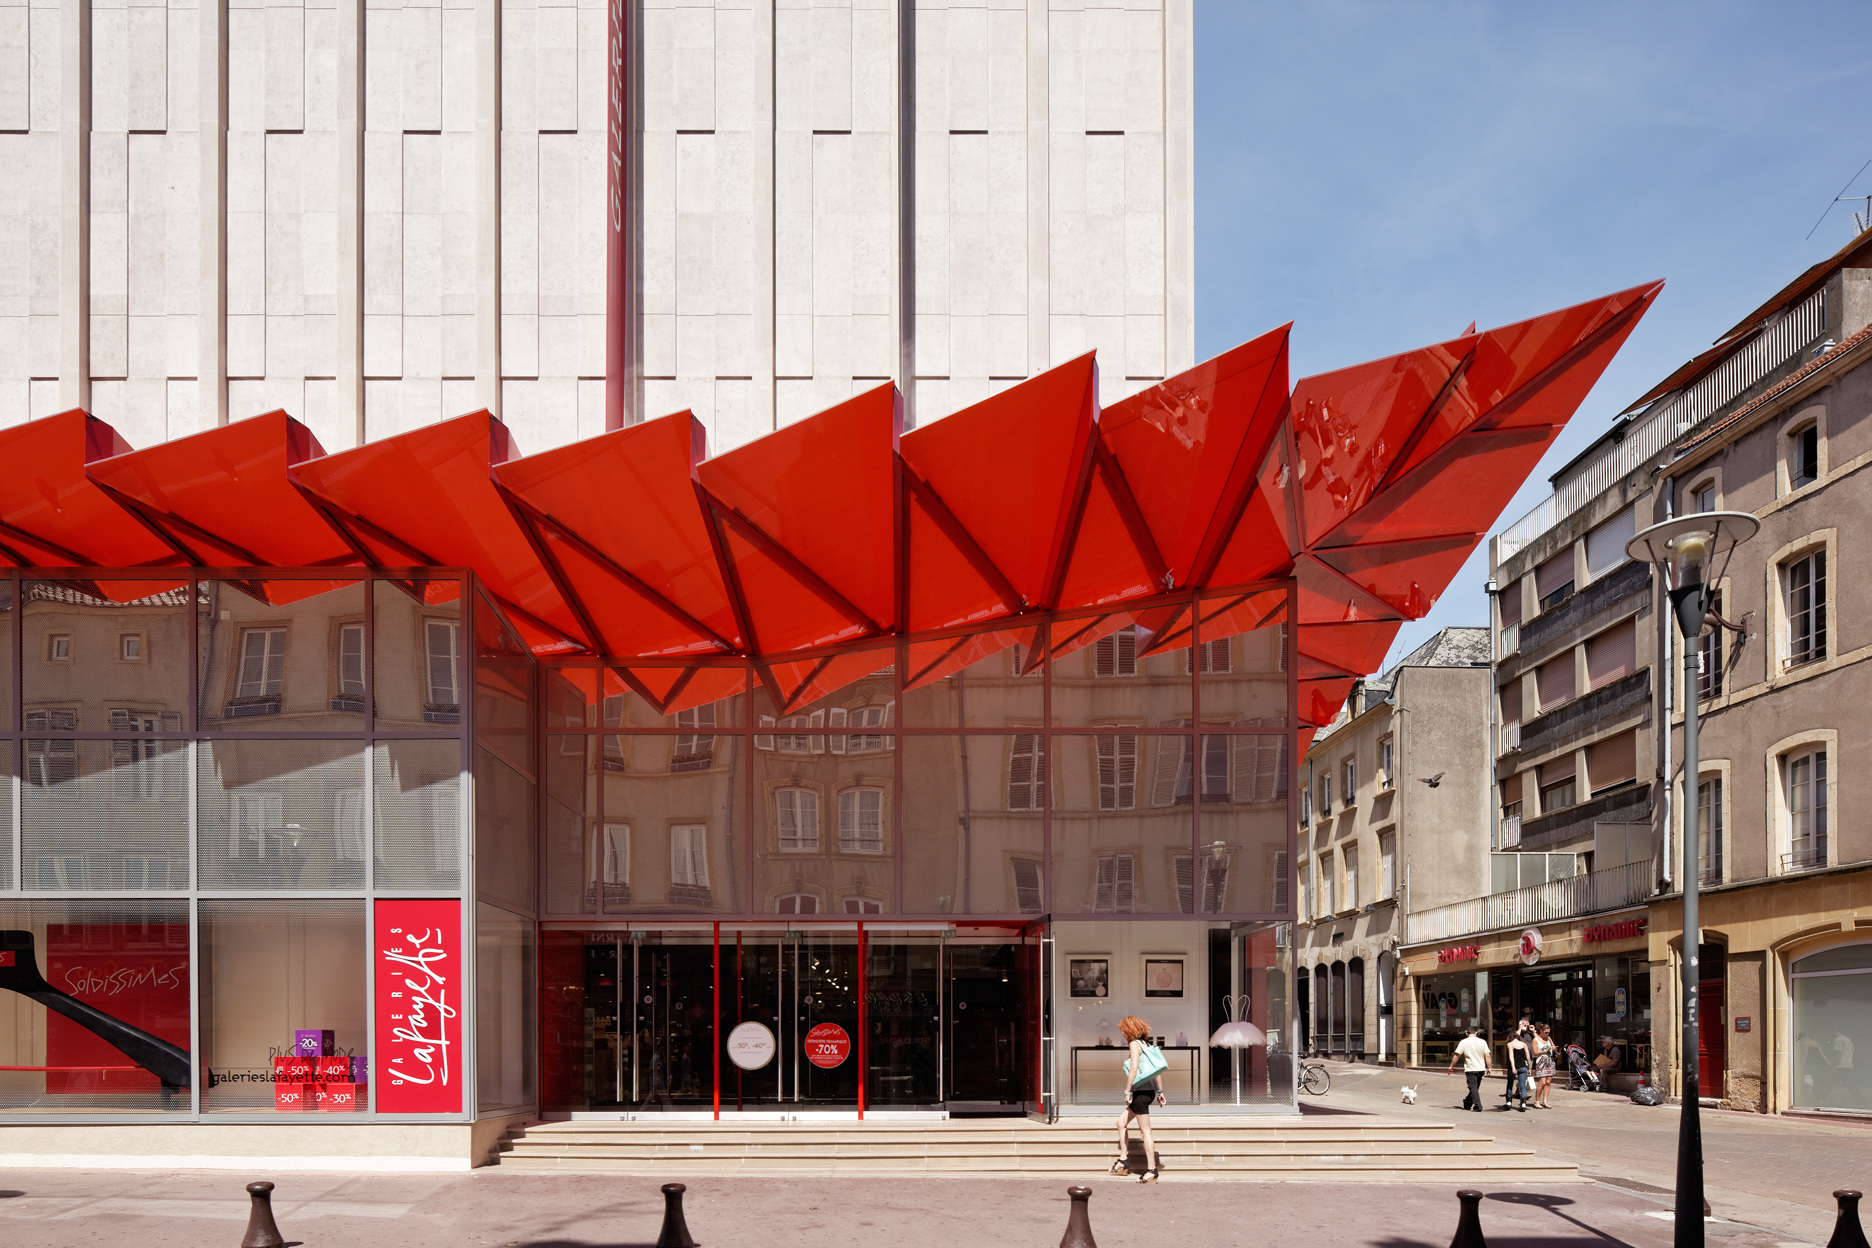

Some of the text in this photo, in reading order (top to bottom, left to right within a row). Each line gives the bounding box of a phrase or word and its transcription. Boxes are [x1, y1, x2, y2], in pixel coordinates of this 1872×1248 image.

[1583, 918, 1648, 944] DYNAMIC
[1438, 944, 1480, 963] DYNAMIC
[383, 927, 456, 1086] Lafayette
[390, 927, 403, 1086] GALERIES
[299, 1039, 318, 1048] -20%
[815, 1044, 838, 1055] -70%
[287, 1065, 310, 1075] -50%
[323, 1065, 346, 1075] -40%
[213, 1070, 356, 1086] galerieslafayette.com
[277, 1092, 300, 1103] -50%
[329, 1092, 352, 1104] -30%
